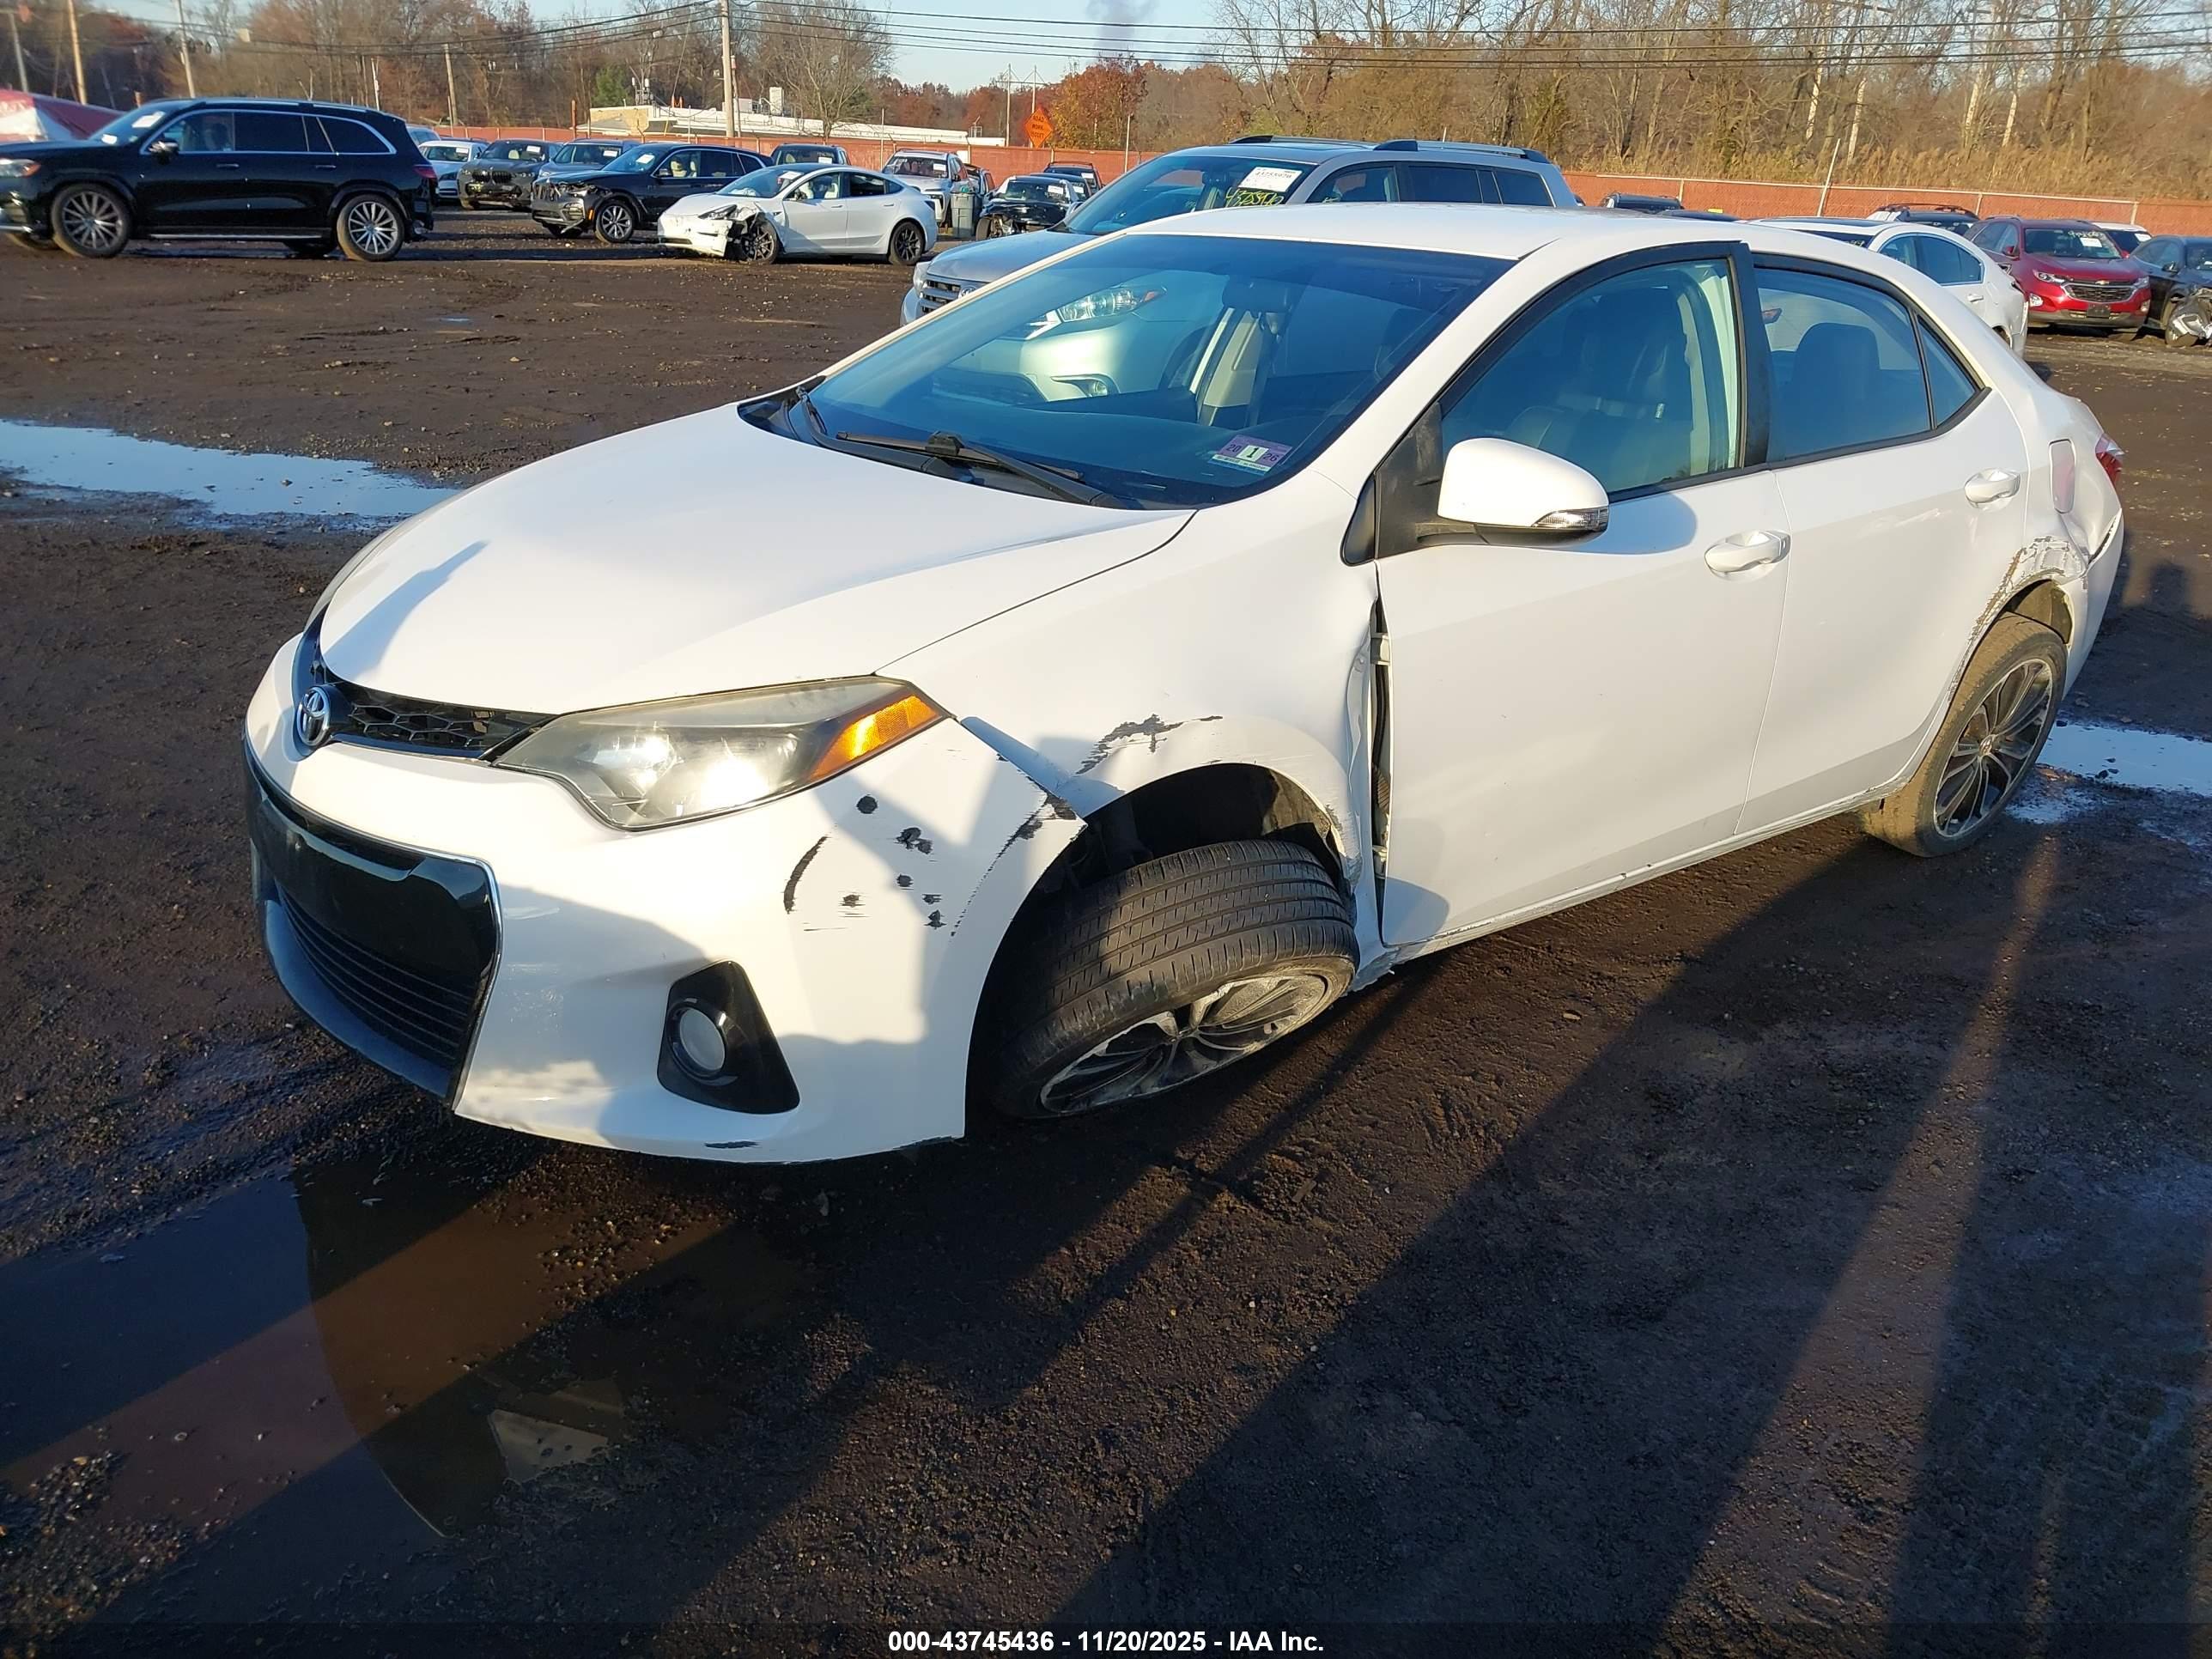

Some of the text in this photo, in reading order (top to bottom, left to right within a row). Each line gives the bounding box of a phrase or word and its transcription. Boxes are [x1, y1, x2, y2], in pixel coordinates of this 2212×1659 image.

[1226, 443, 1278, 462] 20 1 26
